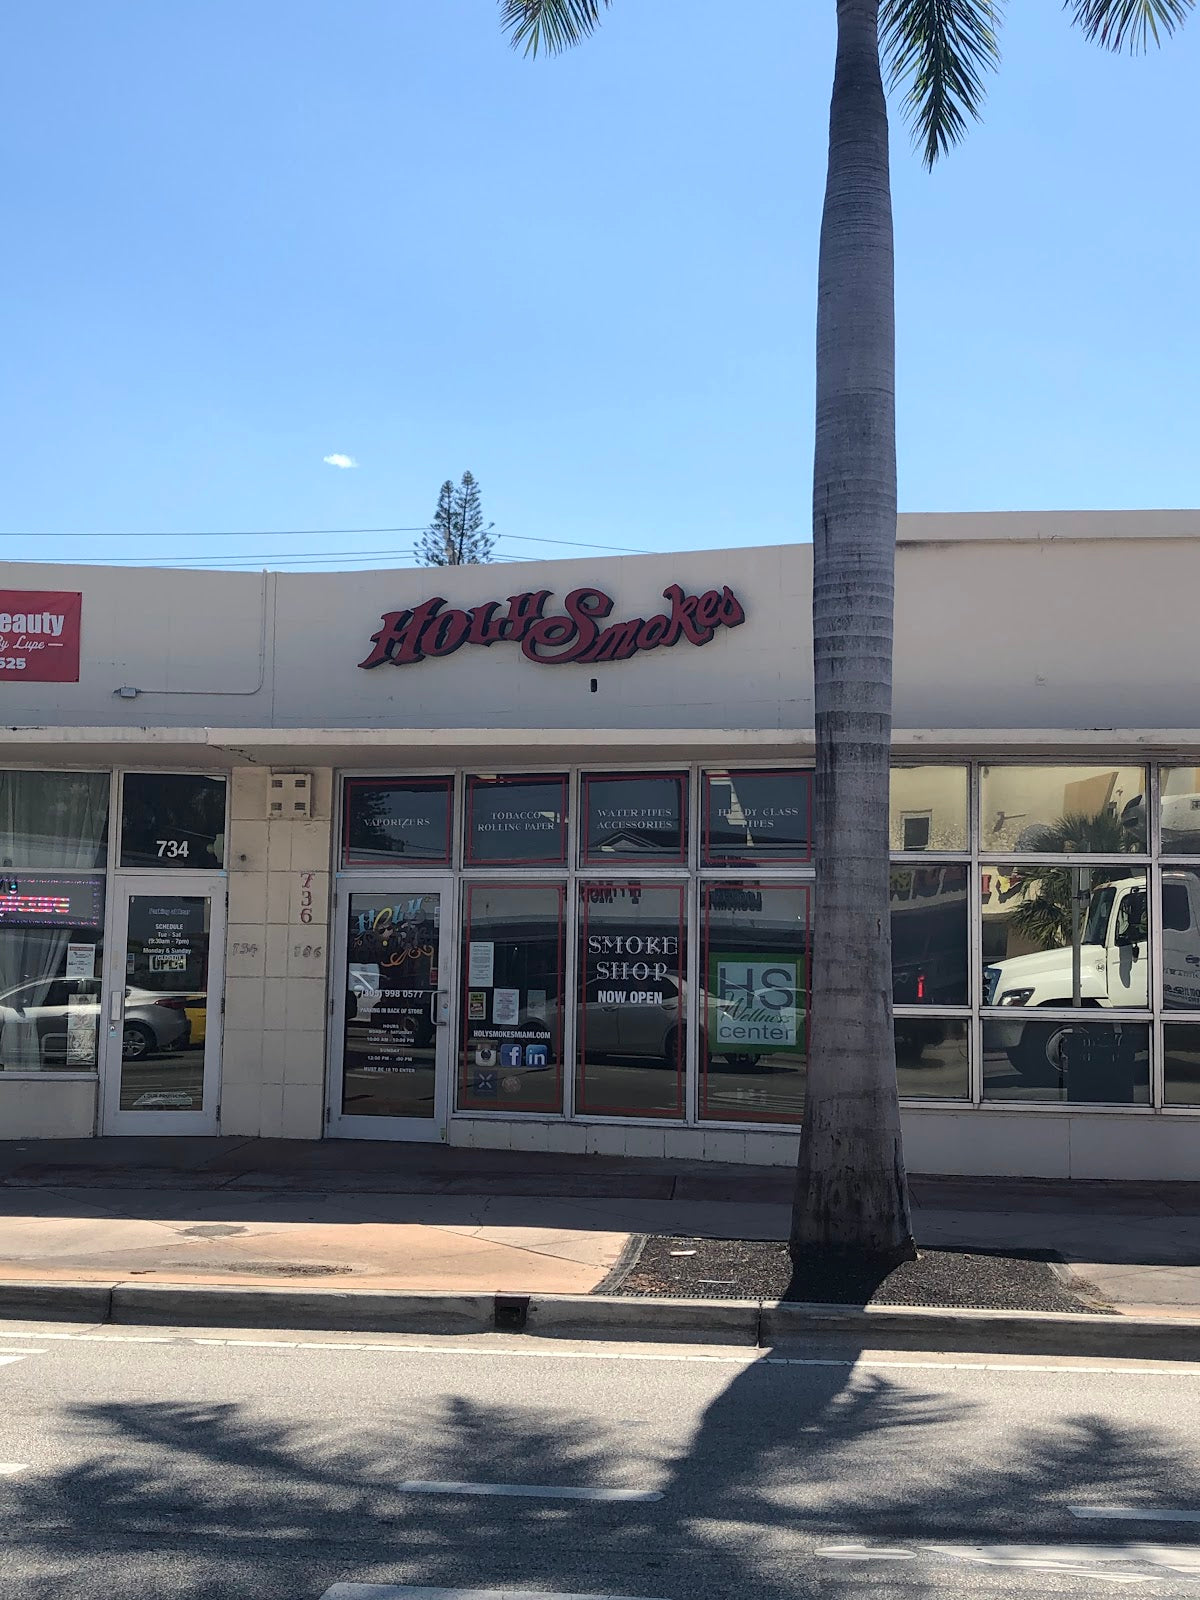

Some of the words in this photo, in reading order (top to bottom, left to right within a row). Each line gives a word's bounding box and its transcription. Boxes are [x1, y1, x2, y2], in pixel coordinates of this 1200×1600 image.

[13, 635, 45, 652] Lupe
[491, 811, 541, 820] TOBACCO
[597, 808, 638, 817] WATER
[641, 808, 672, 817] PIPES
[762, 808, 799, 817] GLASS
[364, 818, 431, 828] VAPORIZERS
[477, 822, 521, 831] ROLLING
[524, 821, 555, 831] PAPER
[596, 820, 673, 829] ACCESSORIES
[156, 840, 189, 858] 734
[300, 872, 315, 924] 736
[588, 935, 678, 955] SMOKE
[143, 947, 165, 955] Monday
[596, 961, 668, 981] SHOP
[719, 967, 794, 1011] HS
[385, 990, 400, 998] 998
[402, 990, 424, 999] 0577
[597, 990, 627, 1003] NOW
[629, 991, 663, 1004] OPEN
[473, 1029, 551, 1039] HOLYSMOKESMIAMI.COM
[719, 1025, 794, 1041] center
